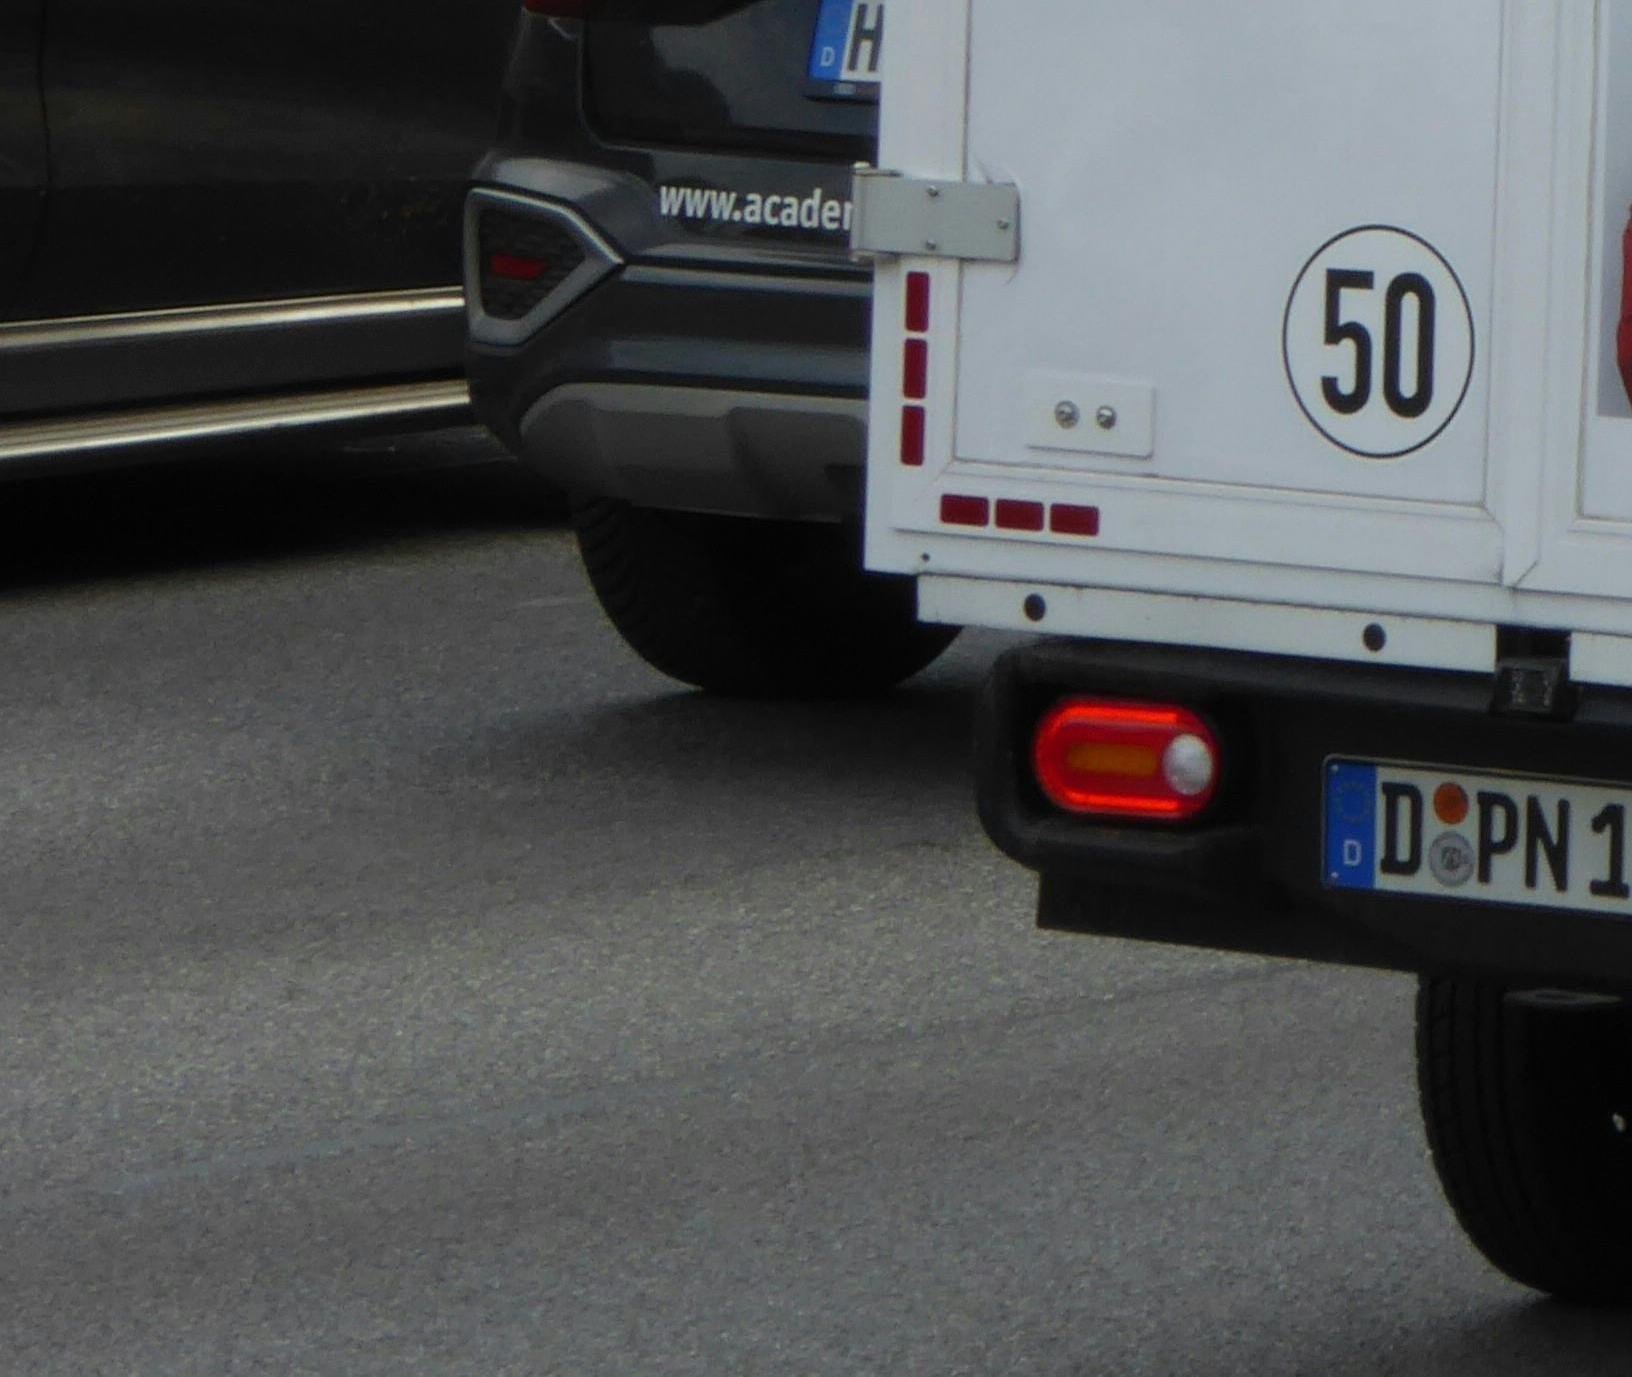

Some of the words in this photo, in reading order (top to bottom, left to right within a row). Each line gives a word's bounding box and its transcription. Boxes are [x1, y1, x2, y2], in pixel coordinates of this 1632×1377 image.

[1320, 268, 1437, 419] 50
[1380, 781, 1424, 876] D
[1476, 790, 1571, 893] PN
